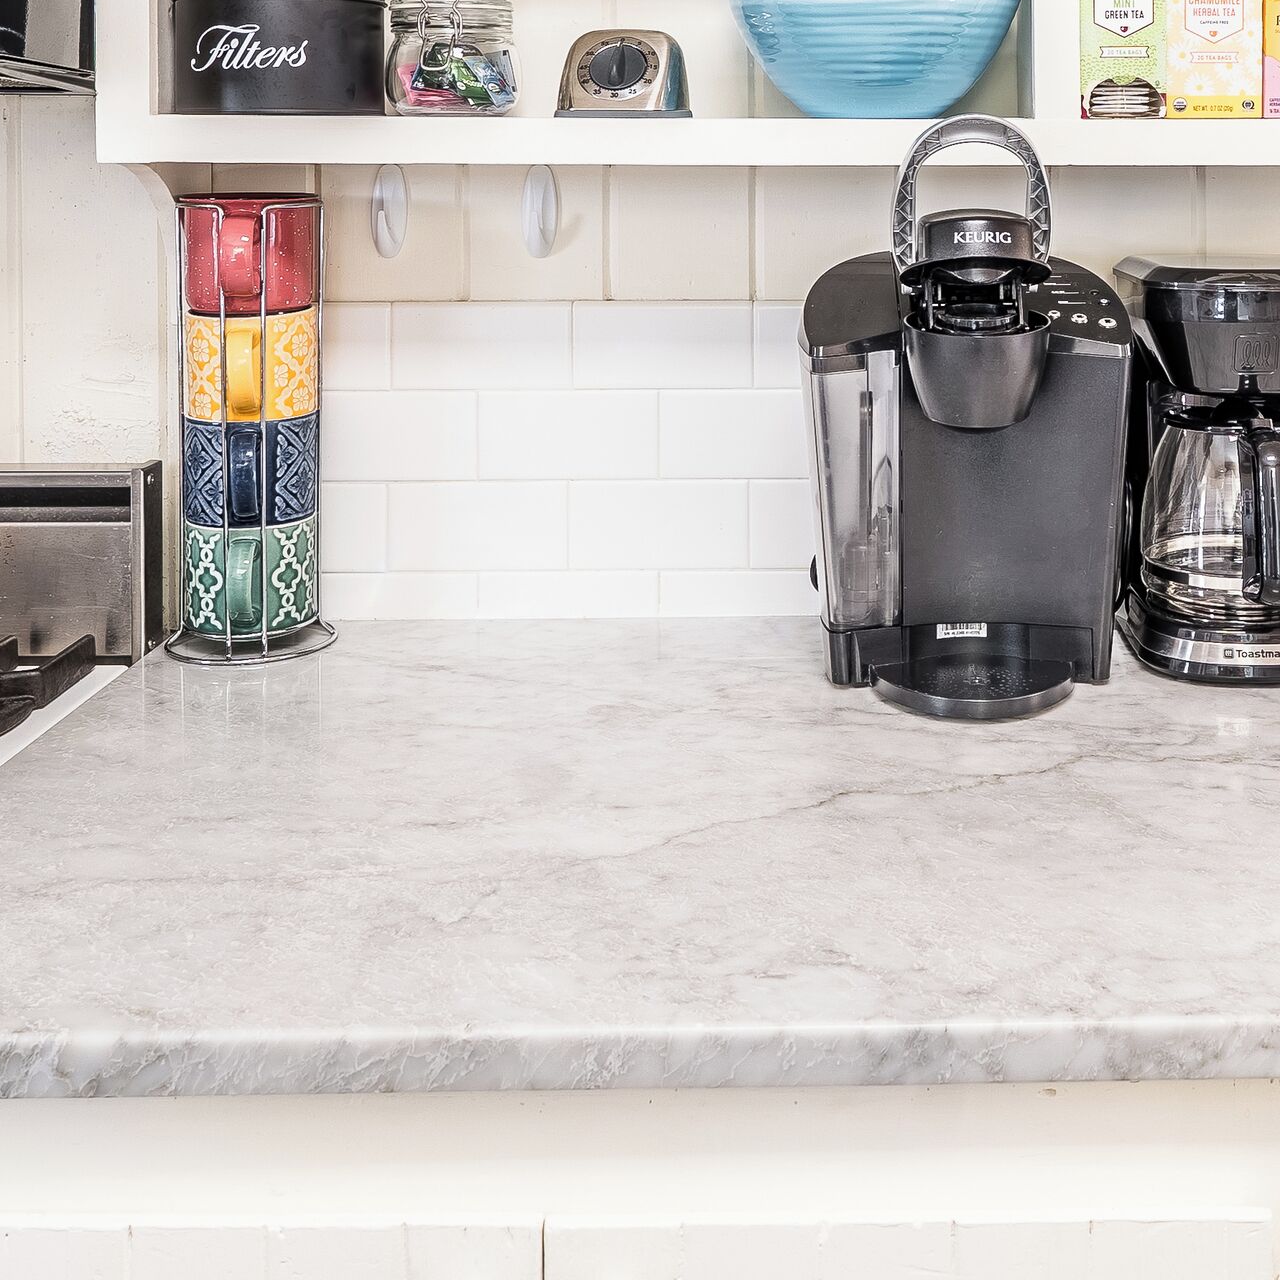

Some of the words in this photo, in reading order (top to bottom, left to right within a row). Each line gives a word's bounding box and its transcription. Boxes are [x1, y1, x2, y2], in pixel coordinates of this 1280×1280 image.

[1104, 10, 1128, 19] GREEN
[1131, 10, 1144, 19] TEA
[1193, 8, 1220, 17] HERBAL
[1223, 8, 1236, 16] TEA
[191, 24, 309, 72] Filters
[953, 231, 1012, 244] KEURIG
